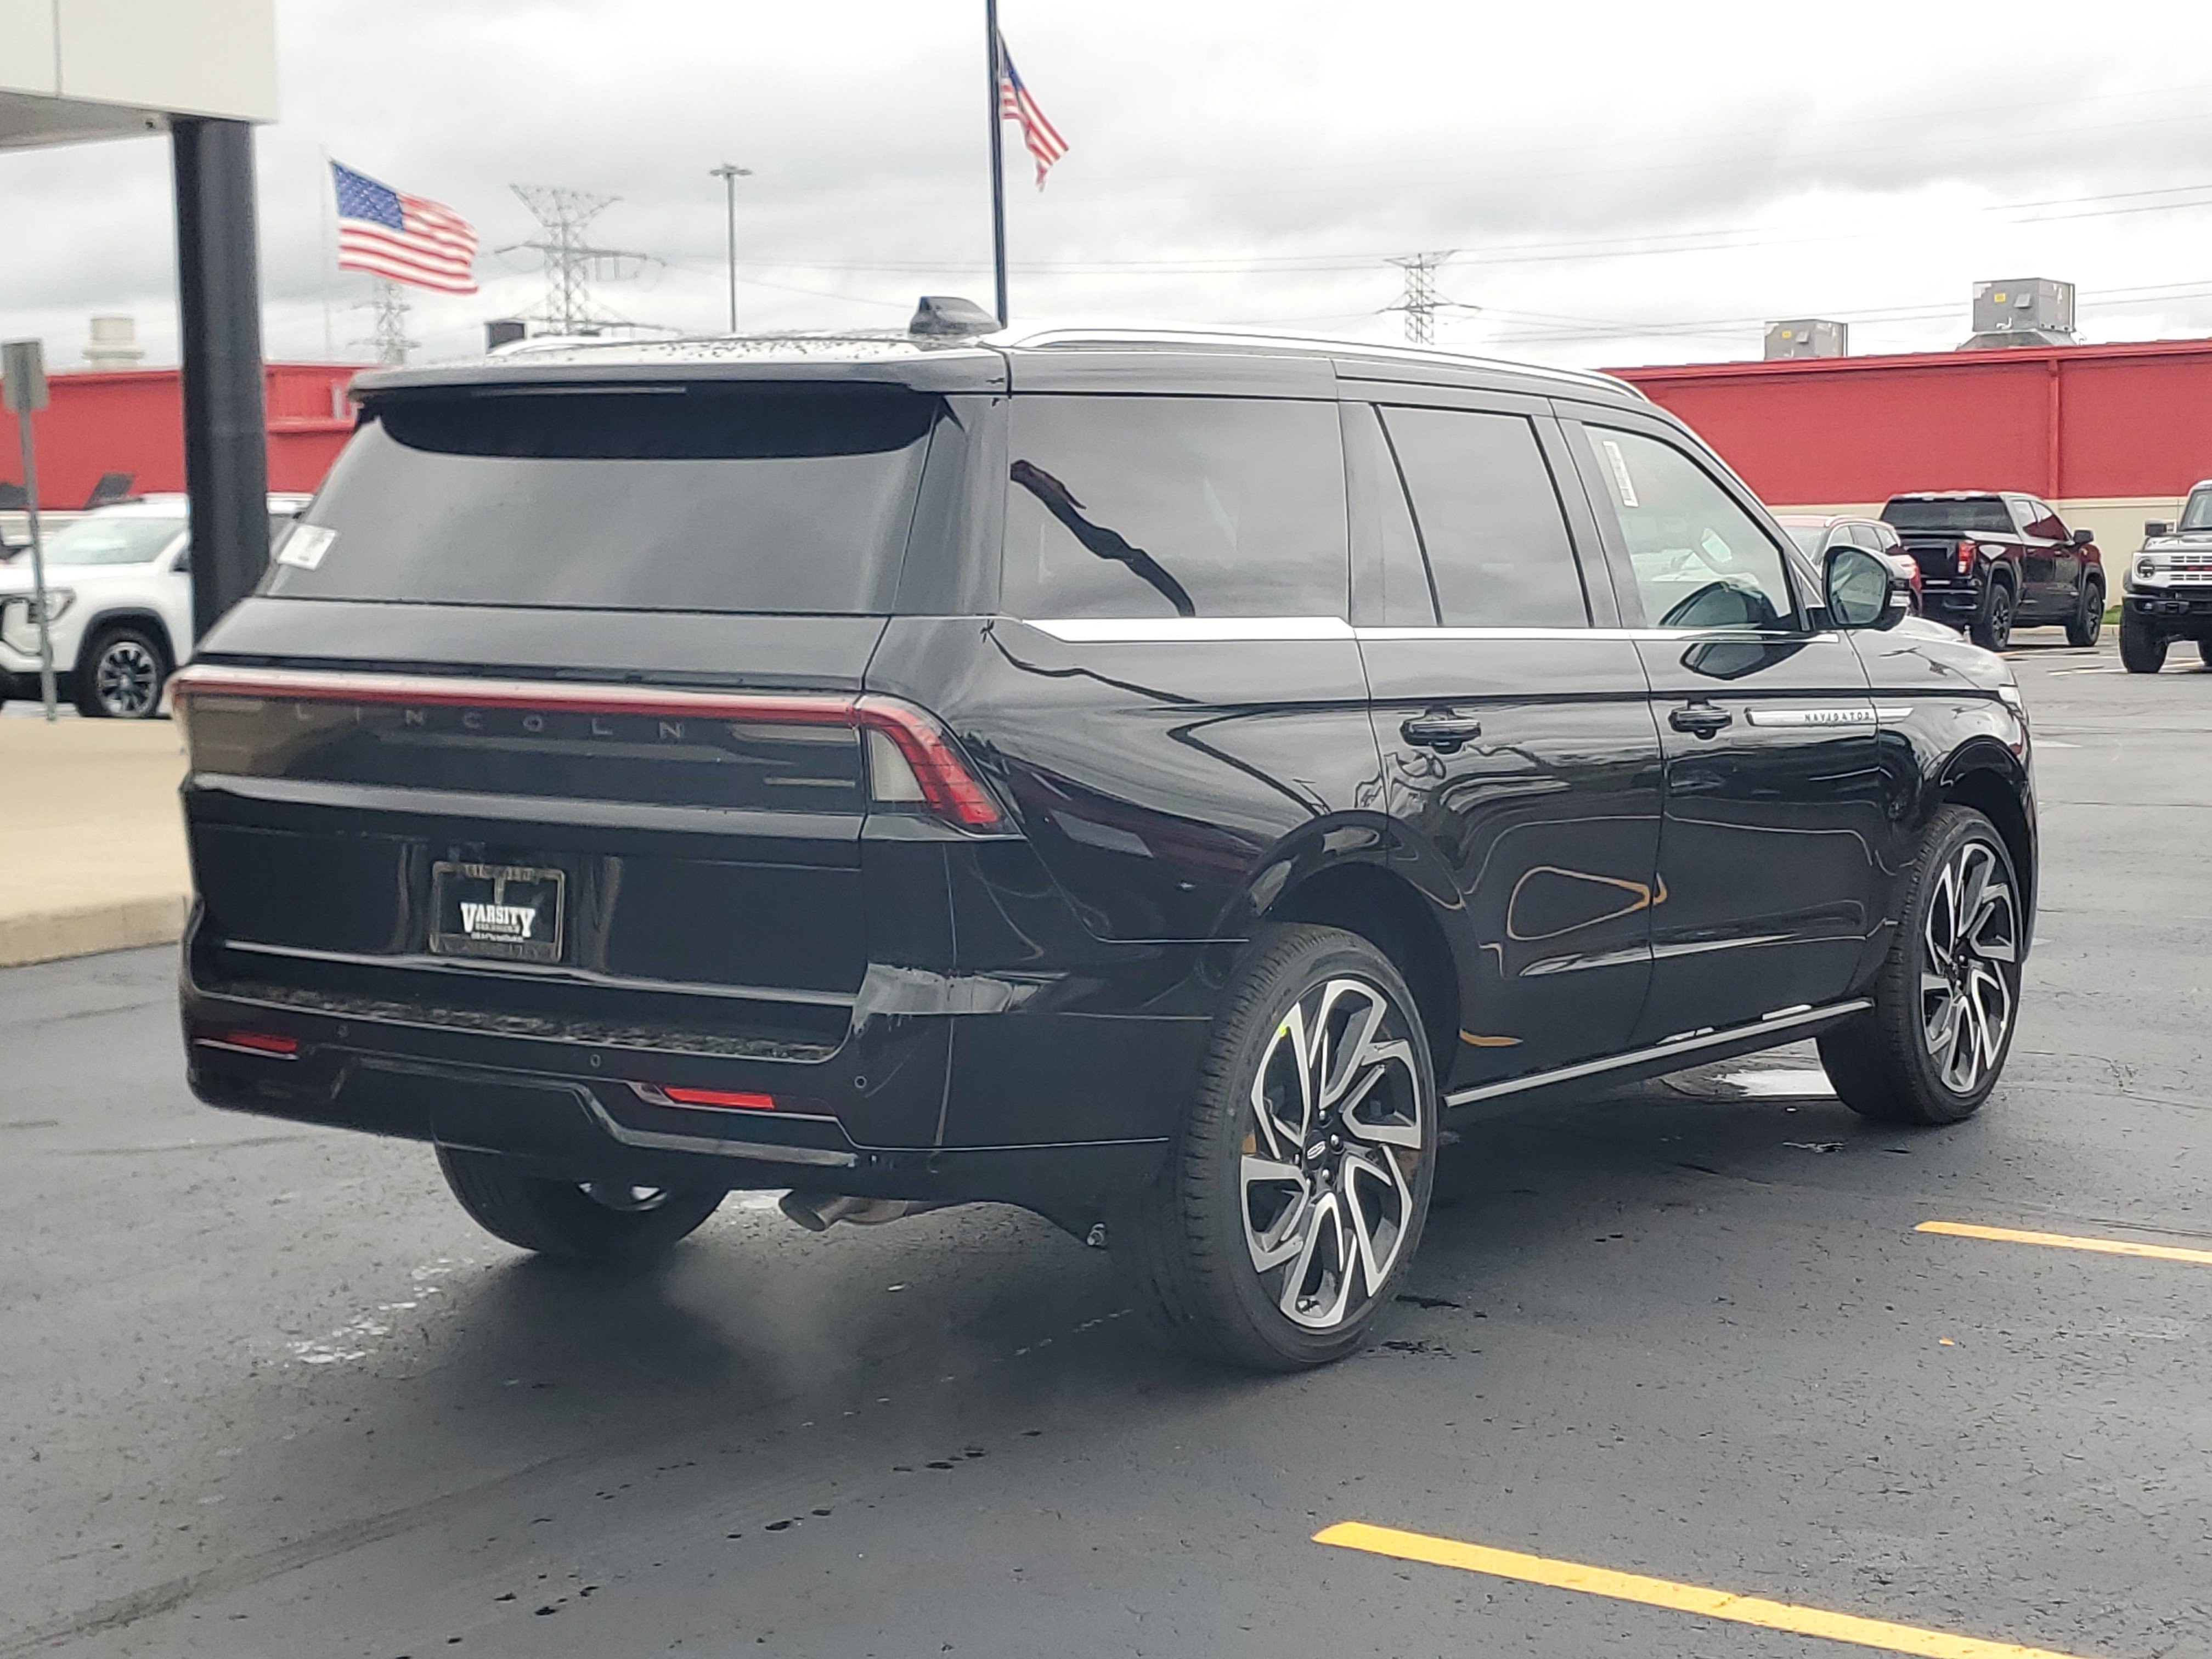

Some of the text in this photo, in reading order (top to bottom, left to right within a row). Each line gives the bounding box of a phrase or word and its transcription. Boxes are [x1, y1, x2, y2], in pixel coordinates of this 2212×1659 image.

[295, 704, 684, 739] LINCOLN
[1805, 712, 1871, 722] NAVIGATOR
[460, 902, 536, 938] VARSITY
